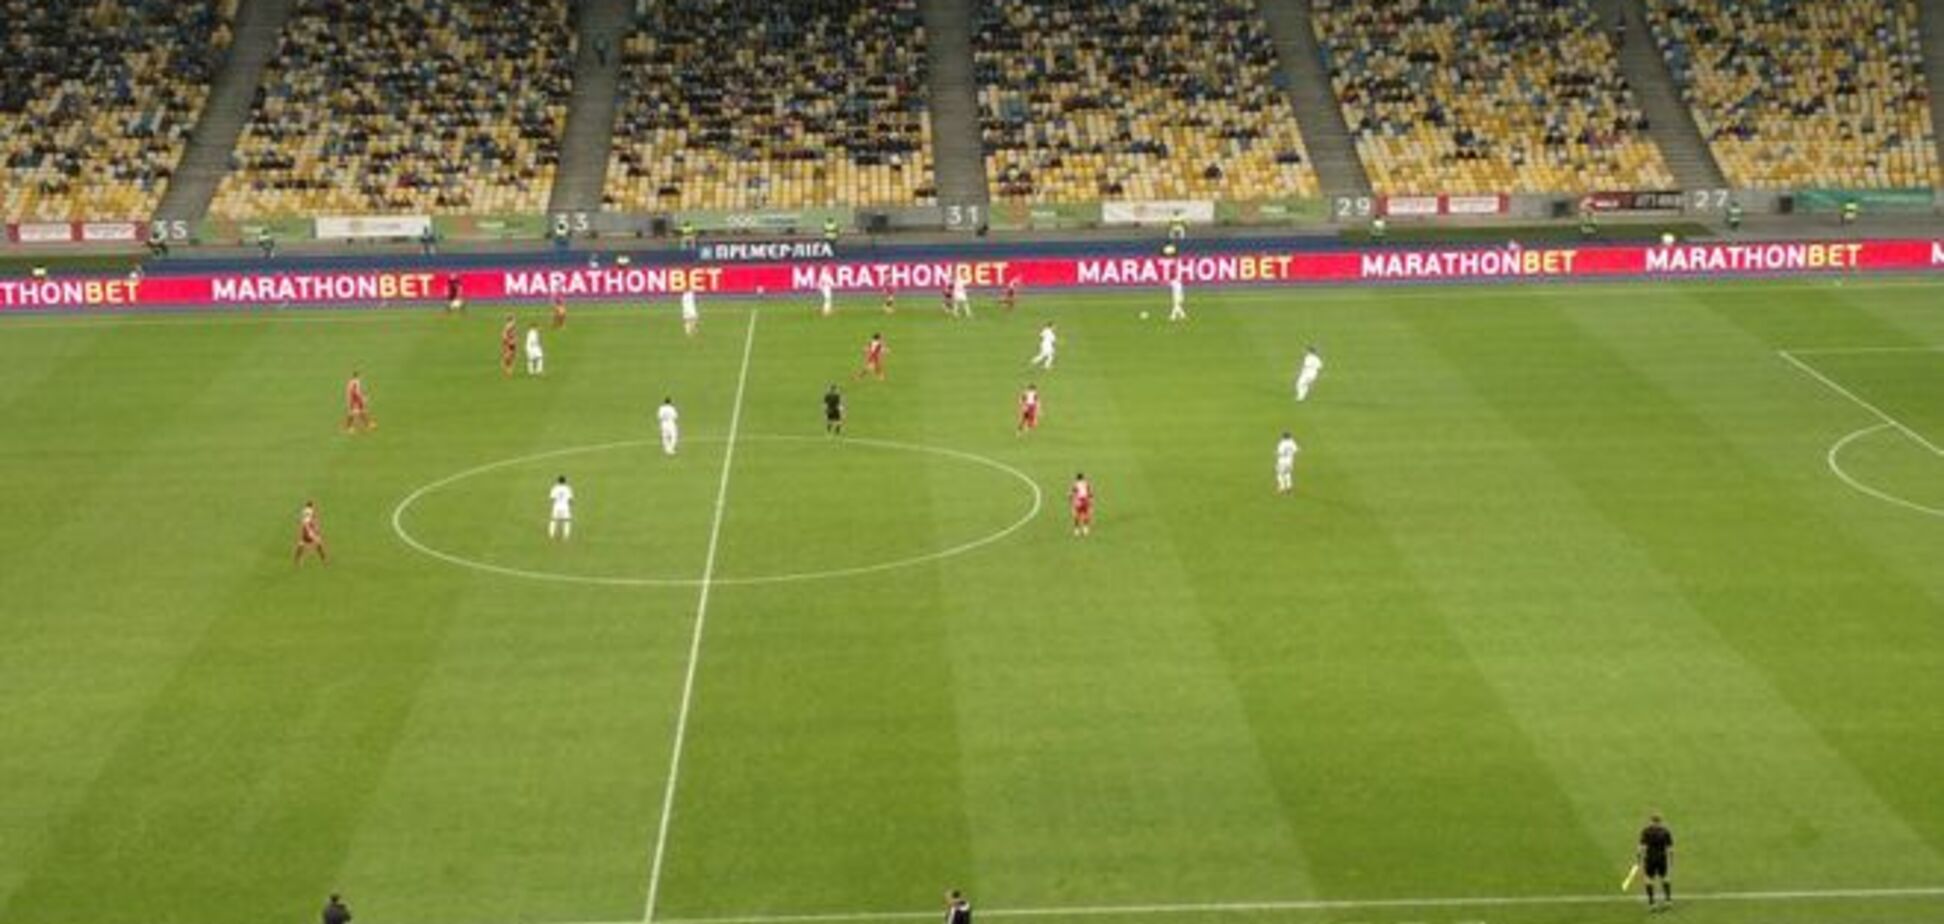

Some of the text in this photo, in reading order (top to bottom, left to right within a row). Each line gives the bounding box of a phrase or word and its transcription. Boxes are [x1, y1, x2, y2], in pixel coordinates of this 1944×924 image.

[1337, 197, 1370, 216] 29
[1694, 189, 1728, 207] 27
[949, 205, 979, 225] 31
[1077, 255, 1294, 283] MARATHONBET
[1361, 250, 1577, 277] MARATHONBET
[1645, 243, 1863, 271] MARATHONBET
[212, 273, 434, 300] MARATHONBET
[504, 267, 722, 294] MARATHONBET
[791, 261, 1009, 289] MARATHONBET
